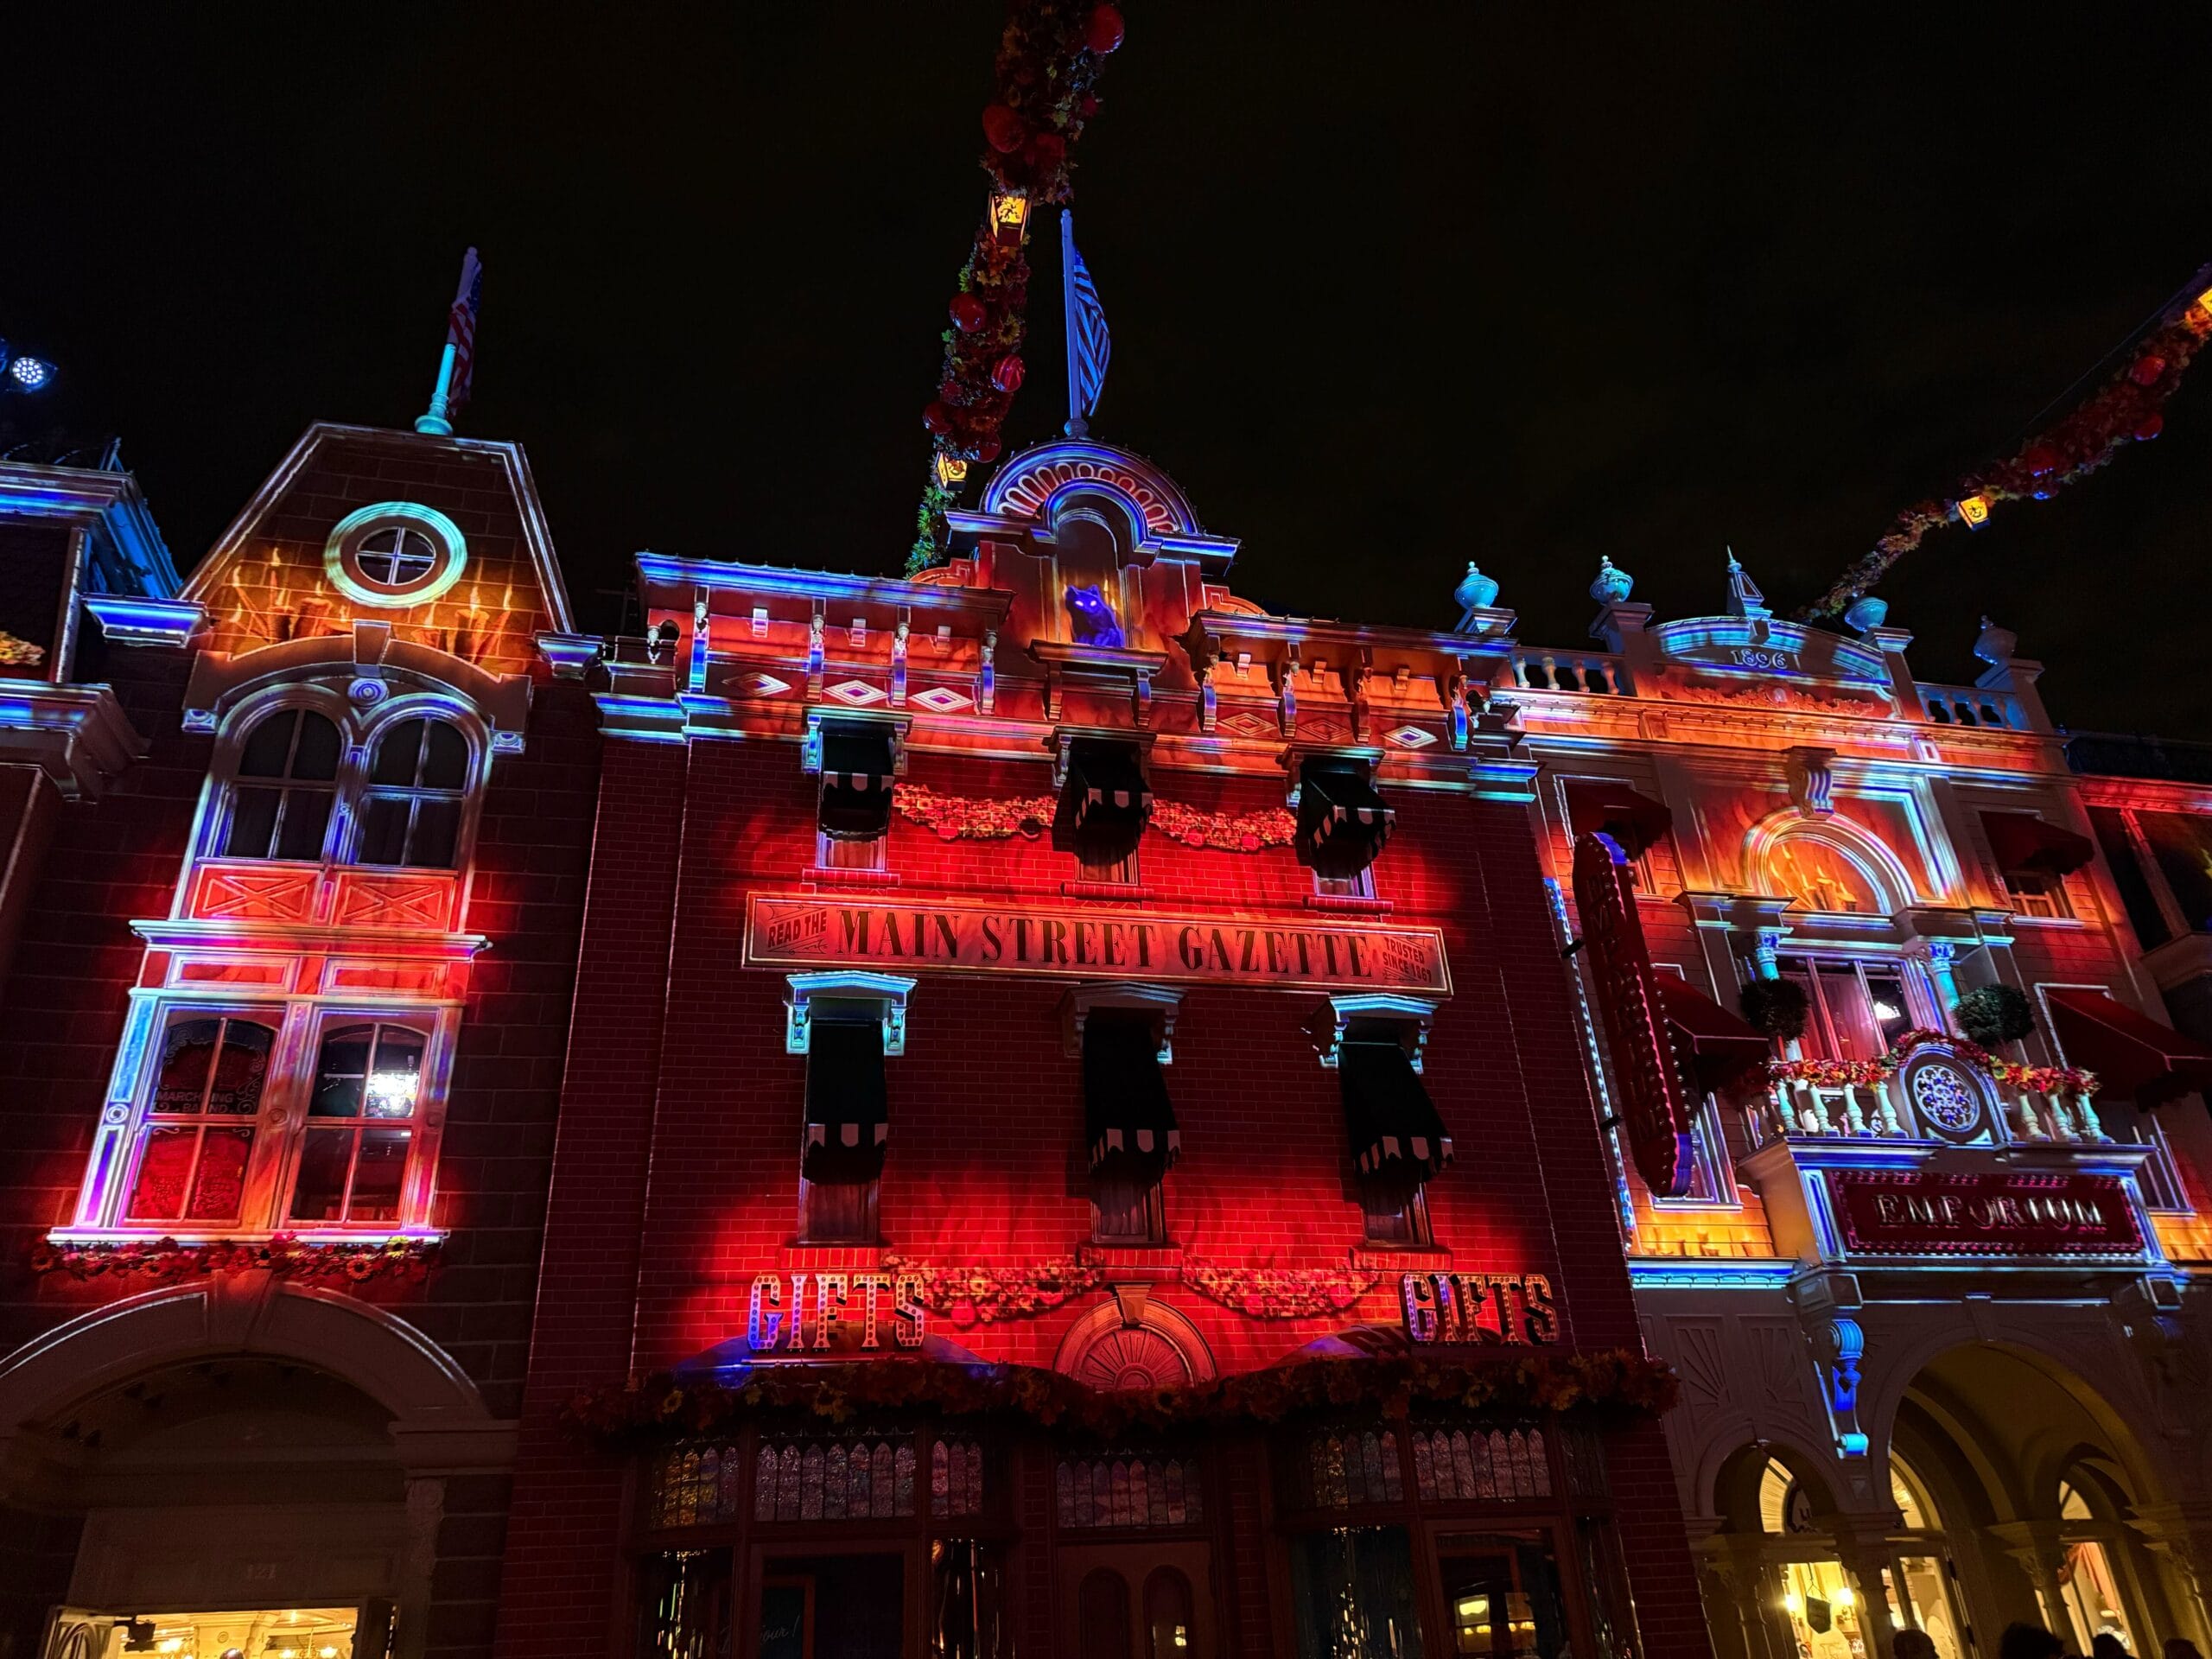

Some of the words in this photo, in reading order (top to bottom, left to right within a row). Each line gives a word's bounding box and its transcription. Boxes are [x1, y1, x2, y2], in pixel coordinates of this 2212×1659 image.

[1731, 648, 1788, 670] 1896
[767, 917, 801, 948] READ
[804, 911, 827, 936] THE
[836, 909, 961, 958] MAIN
[982, 916, 1156, 969] STREET
[1178, 925, 1373, 978] GAZETTE
[1382, 951, 1409, 974] SINCE
[1383, 937, 1425, 964] TRUSTED
[1873, 1193, 2107, 1231] EMPORIUM
[748, 1274, 925, 1351] GIFTS
[1400, 1274, 1560, 1343] GIFTS
